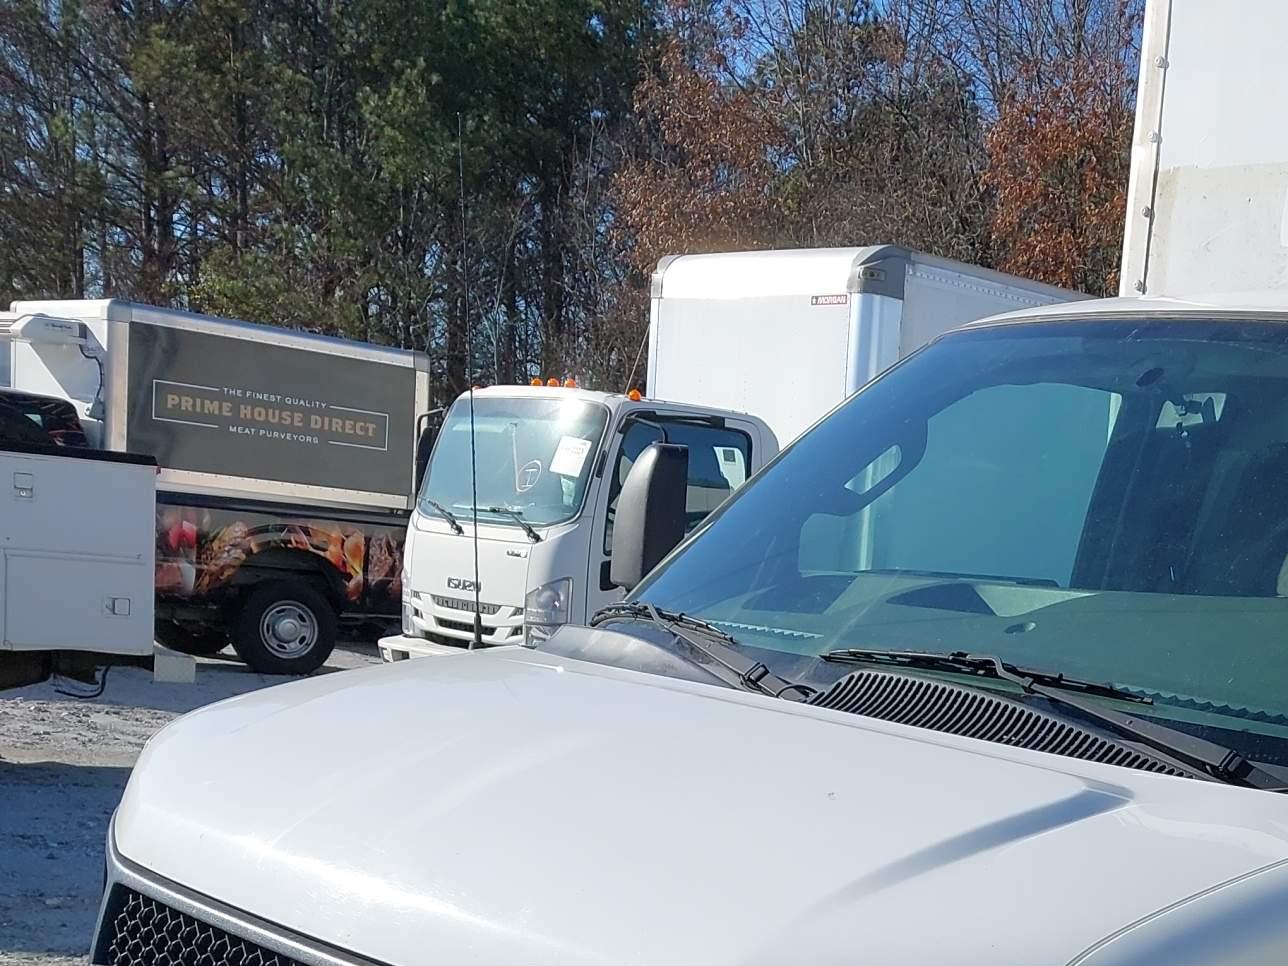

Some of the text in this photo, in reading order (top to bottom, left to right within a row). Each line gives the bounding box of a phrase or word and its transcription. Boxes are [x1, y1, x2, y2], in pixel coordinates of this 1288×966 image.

[223, 387, 327, 409] THE FINEST QUALITY
[167, 394, 376, 436] PRIME HOUSE DIRECT
[229, 425, 319, 444] MEAT PURVEYORS
[447, 577, 481, 592] ISUZU
